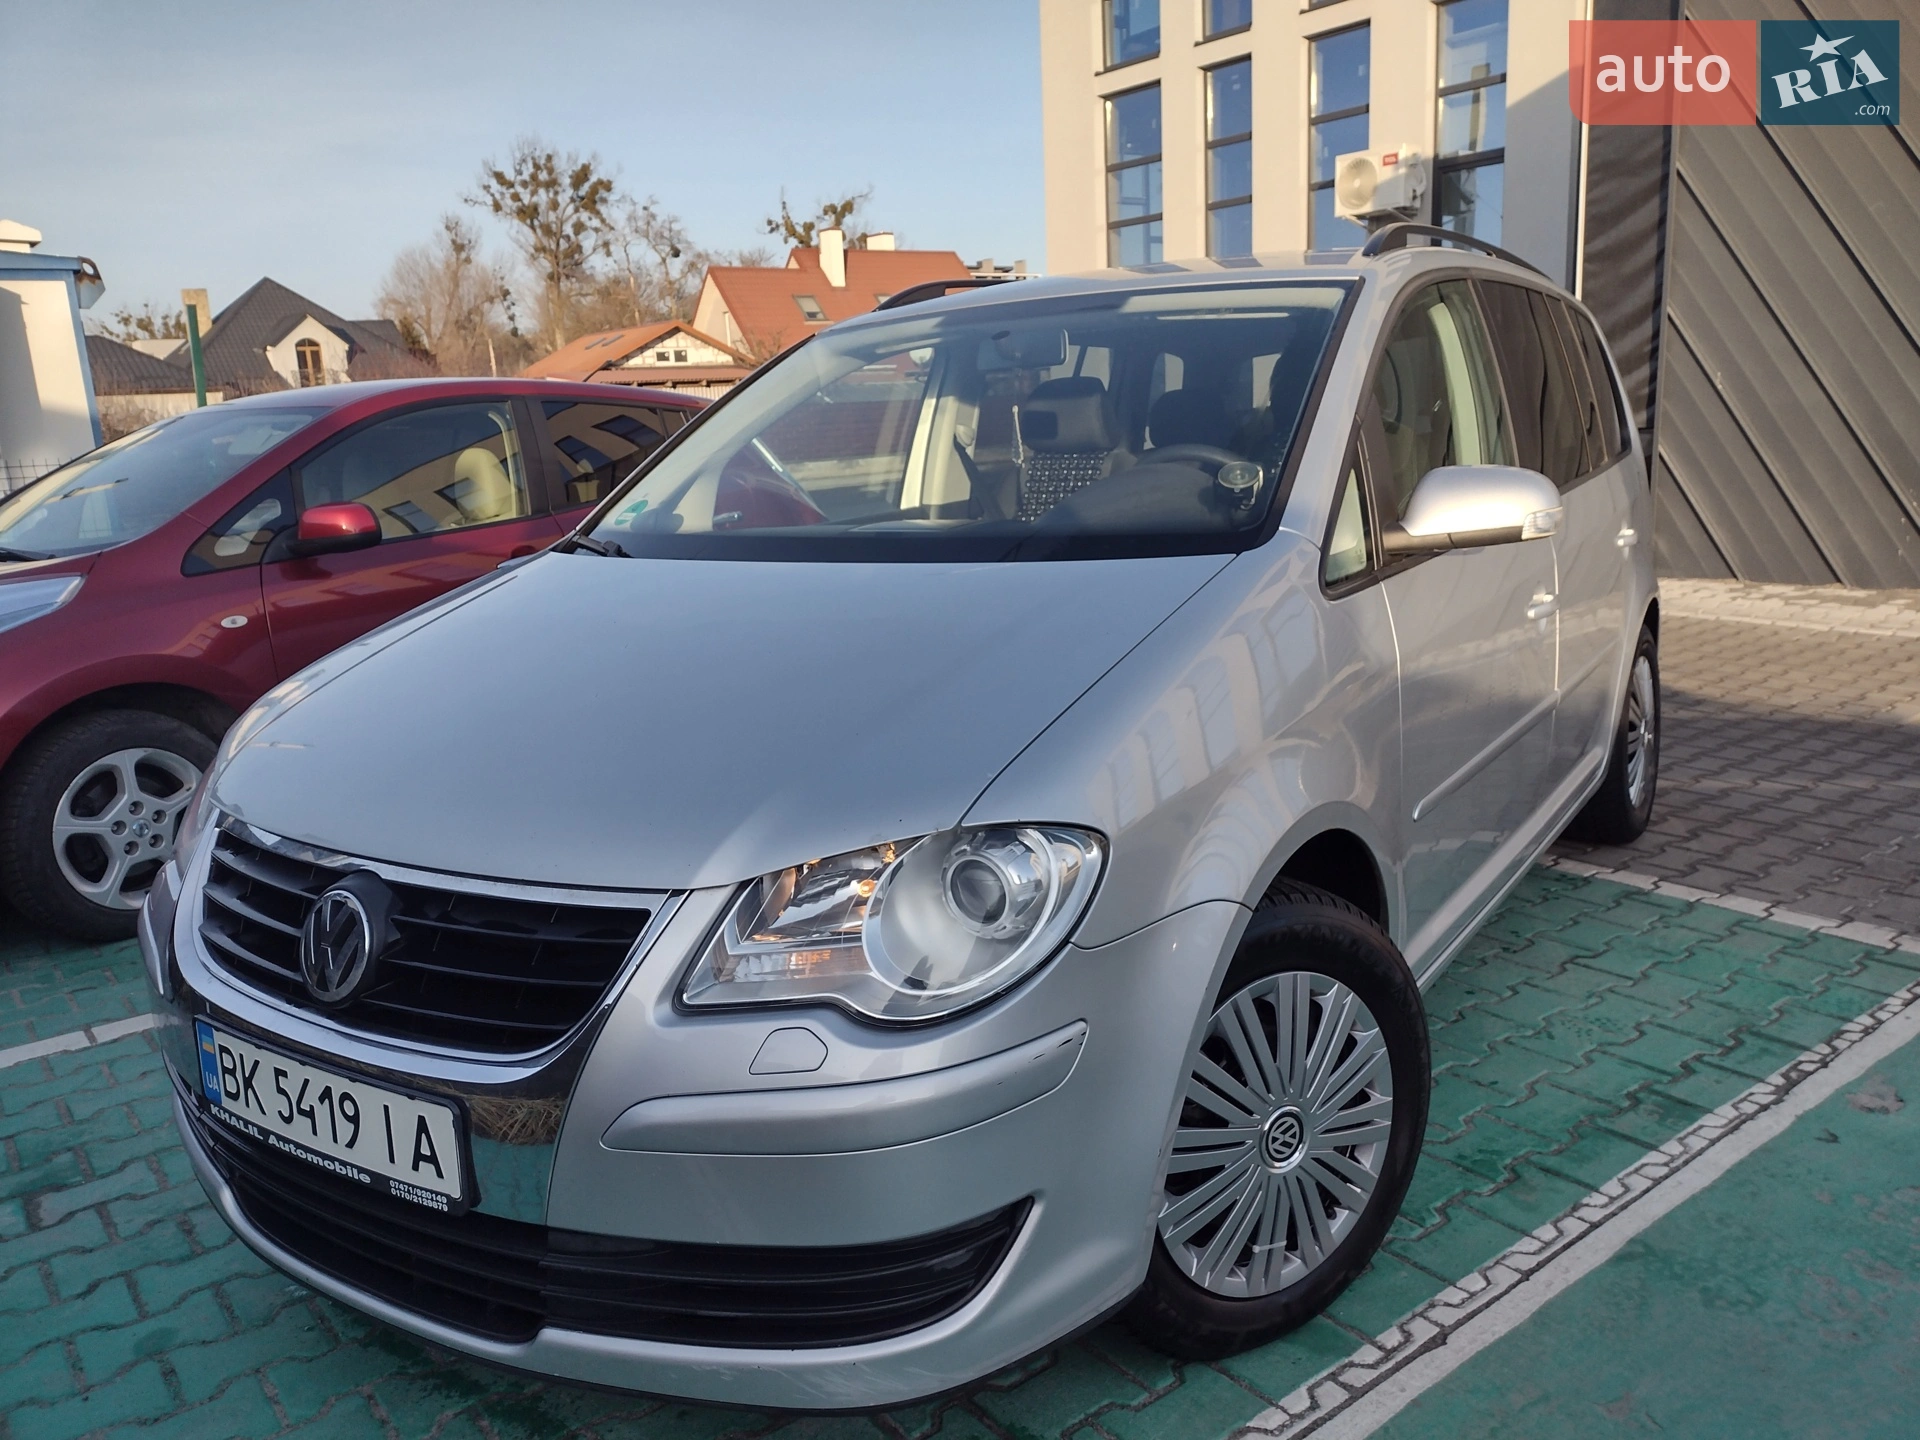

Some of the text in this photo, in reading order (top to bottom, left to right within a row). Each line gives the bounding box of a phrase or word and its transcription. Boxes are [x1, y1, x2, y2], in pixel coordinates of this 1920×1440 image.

[205, 1071, 219, 1093] UA
[218, 1043, 445, 1179] BK 5419 IA
[210, 1104, 371, 1184] KHALIL Automobile
